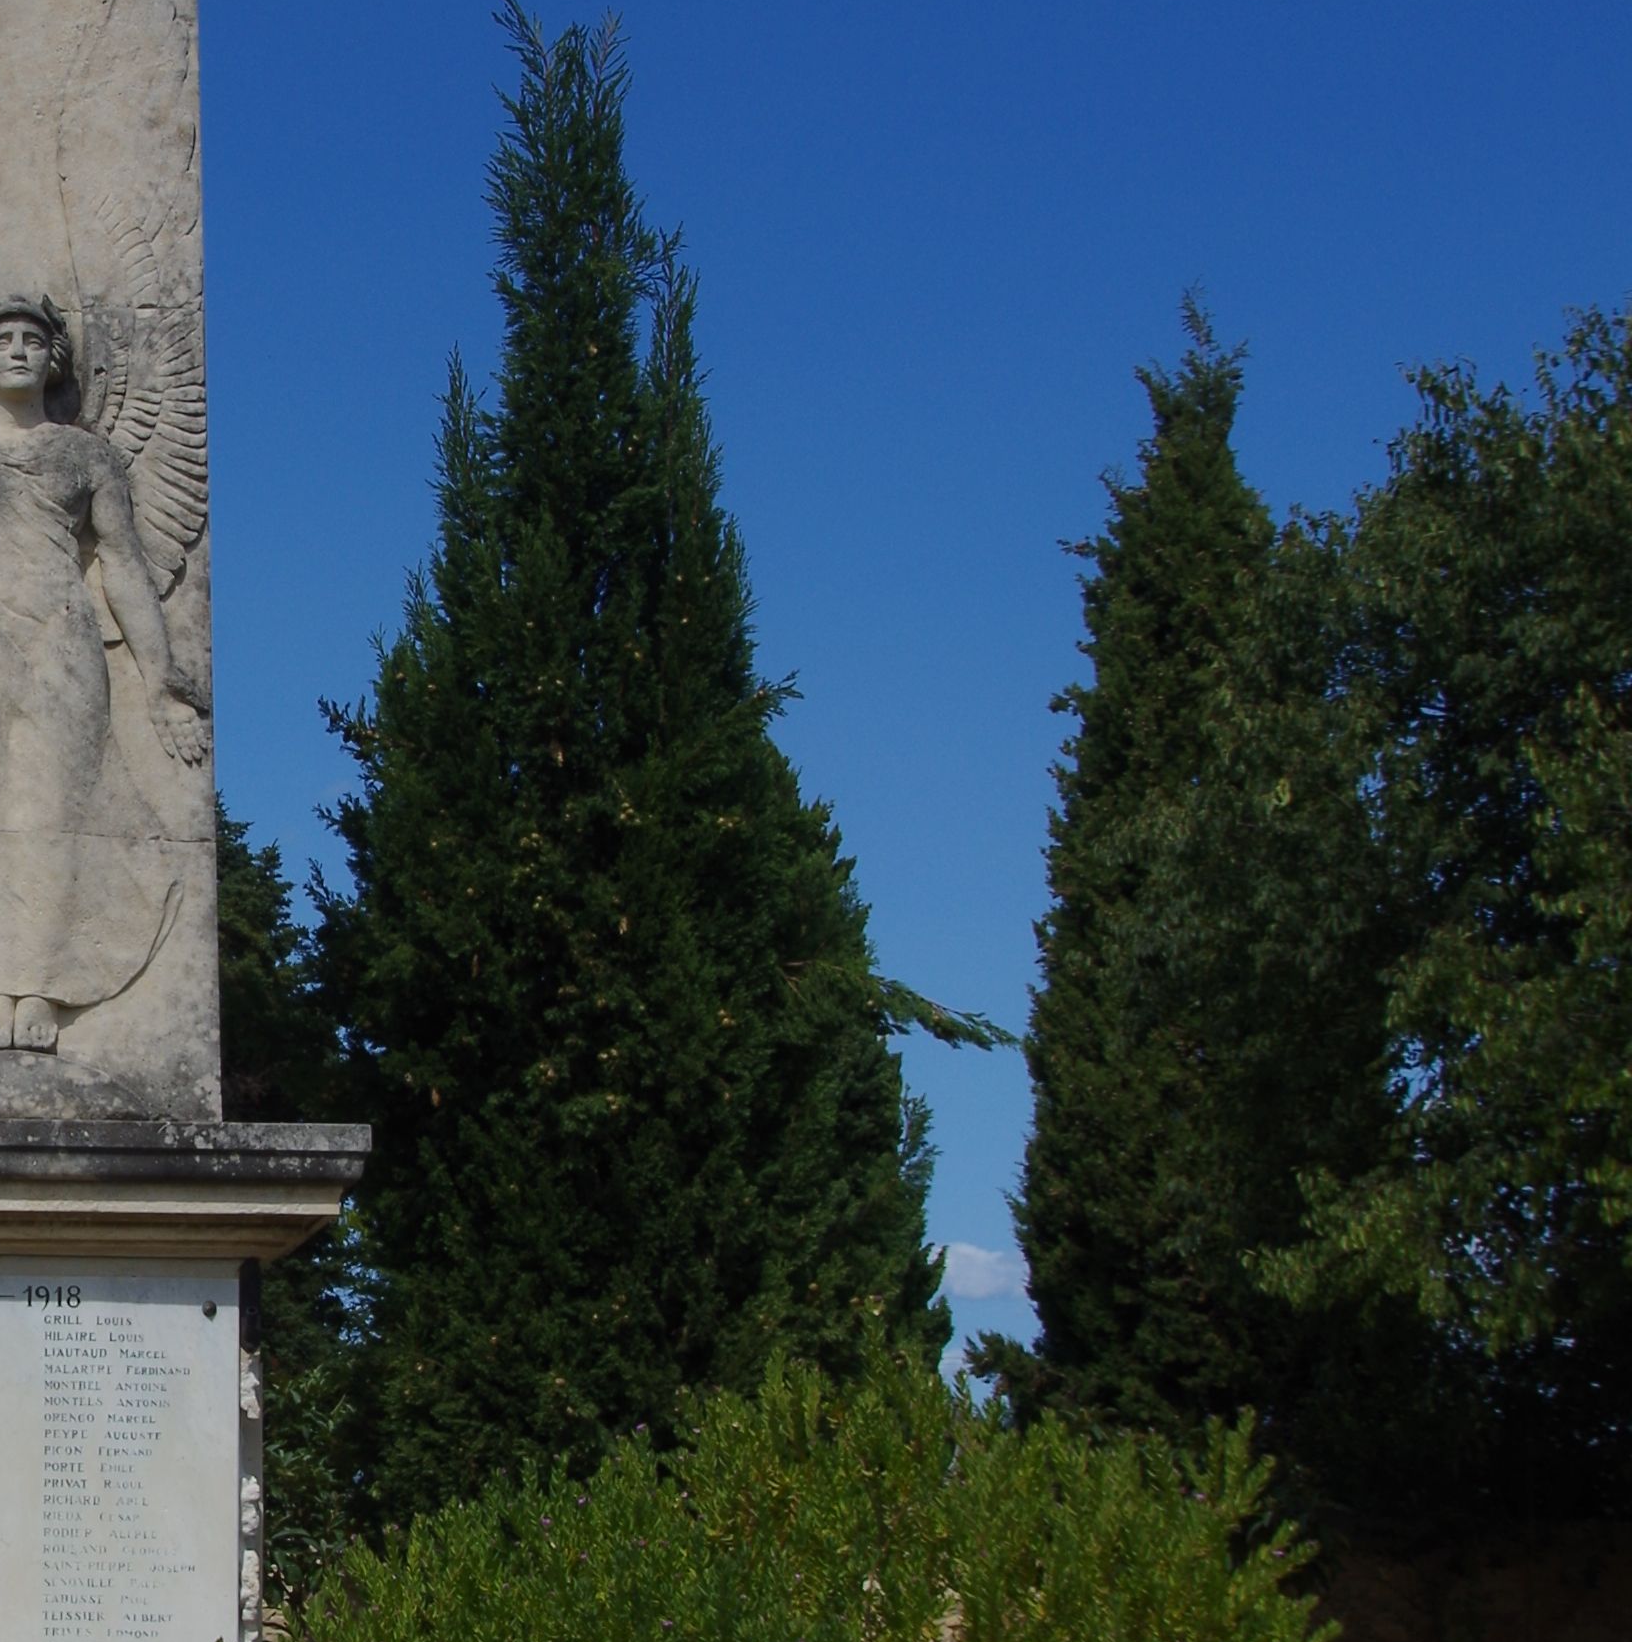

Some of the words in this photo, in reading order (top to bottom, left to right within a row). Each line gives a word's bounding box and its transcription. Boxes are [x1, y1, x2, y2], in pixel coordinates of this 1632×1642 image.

[23, 1285, 81, 1310] 1918
[44, 1315, 82, 1325] GRILL
[97, 1316, 133, 1326] LOUIS
[44, 1331, 97, 1341] HILAIRE
[109, 1332, 144, 1342] LOUIS
[44, 1348, 107, 1358] LIAUTAUD
[120, 1349, 167, 1359] MARCEL
[126, 1365, 190, 1375] FERDINAND
[115, 1382, 167, 1391] ANTOINE
[107, 1414, 156, 1424] MARCEL
[105, 1431, 162, 1440] AUGUSTE
[44, 1446, 82, 1456] PICON
[98, 1446, 152, 1456] FERNAND
[44, 1462, 85, 1472] PORTE
[100, 1463, 135, 1473] EMILE
[44, 1479, 87, 1489] PRIVAT
[104, 1480, 143, 1489] RAOUL
[44, 1495, 101, 1506] RICHARD
[43, 1561, 134, 1571] SAINT-PIERRE
[150, 1565, 195, 1573] JOSEPH
[43, 1611, 105, 1621] TEISSIER
[124, 1613, 174, 1622] ALBERT
[107, 1629, 158, 1638] EDMOND
